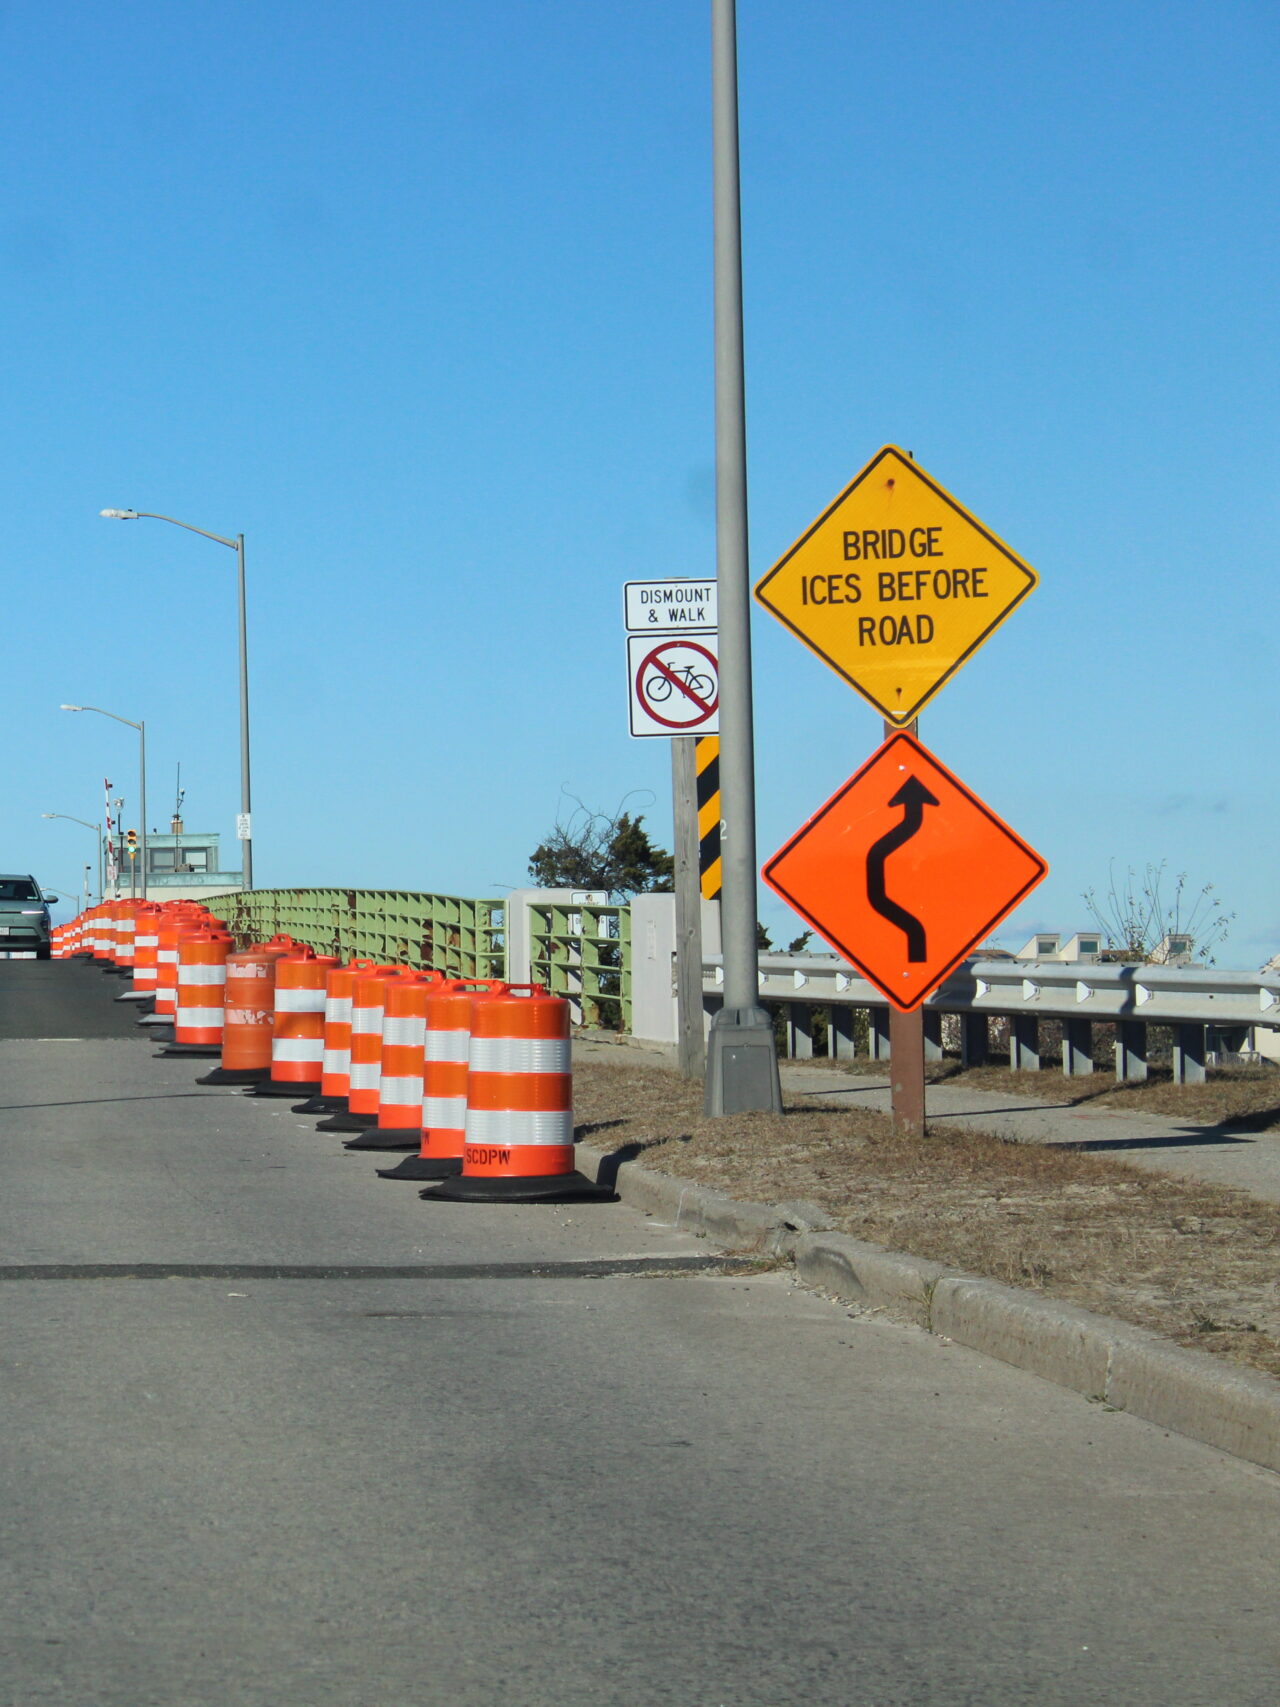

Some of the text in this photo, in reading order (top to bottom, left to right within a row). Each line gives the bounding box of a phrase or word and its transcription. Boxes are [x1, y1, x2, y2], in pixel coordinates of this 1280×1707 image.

[843, 526, 944, 561] BRIDGE
[640, 587, 711, 604] DISMOUNT
[801, 567, 989, 605] ICES BEFORE
[648, 607, 706, 623] & WALK
[858, 614, 935, 647] ROAD
[466, 1148, 511, 1165] SCDPW
